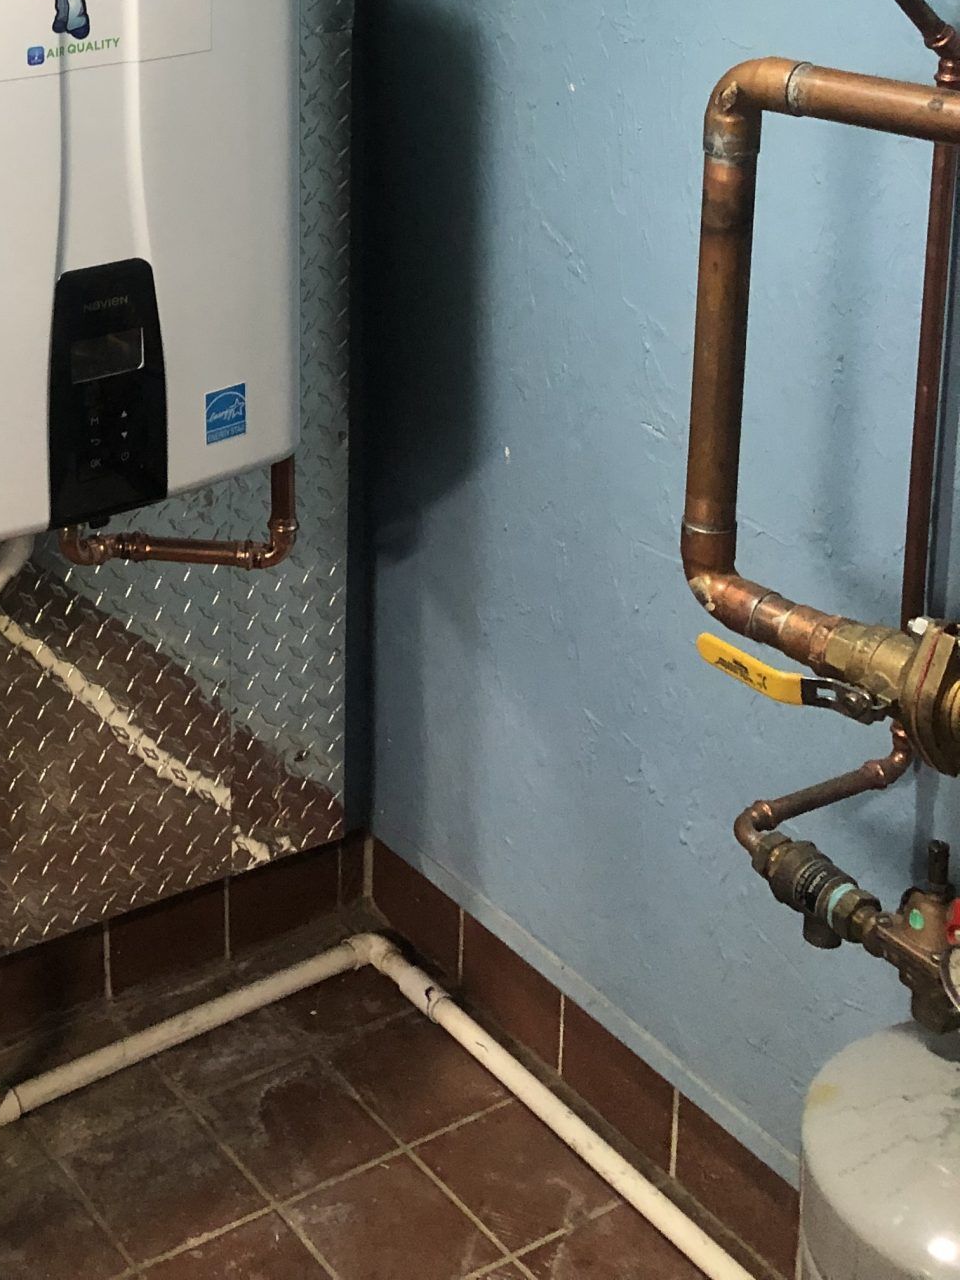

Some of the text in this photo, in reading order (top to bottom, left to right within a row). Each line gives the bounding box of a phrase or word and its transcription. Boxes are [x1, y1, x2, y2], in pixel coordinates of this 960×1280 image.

[46, 37, 121, 59] AIR QUALITY
[90, 458, 102, 469] OK
